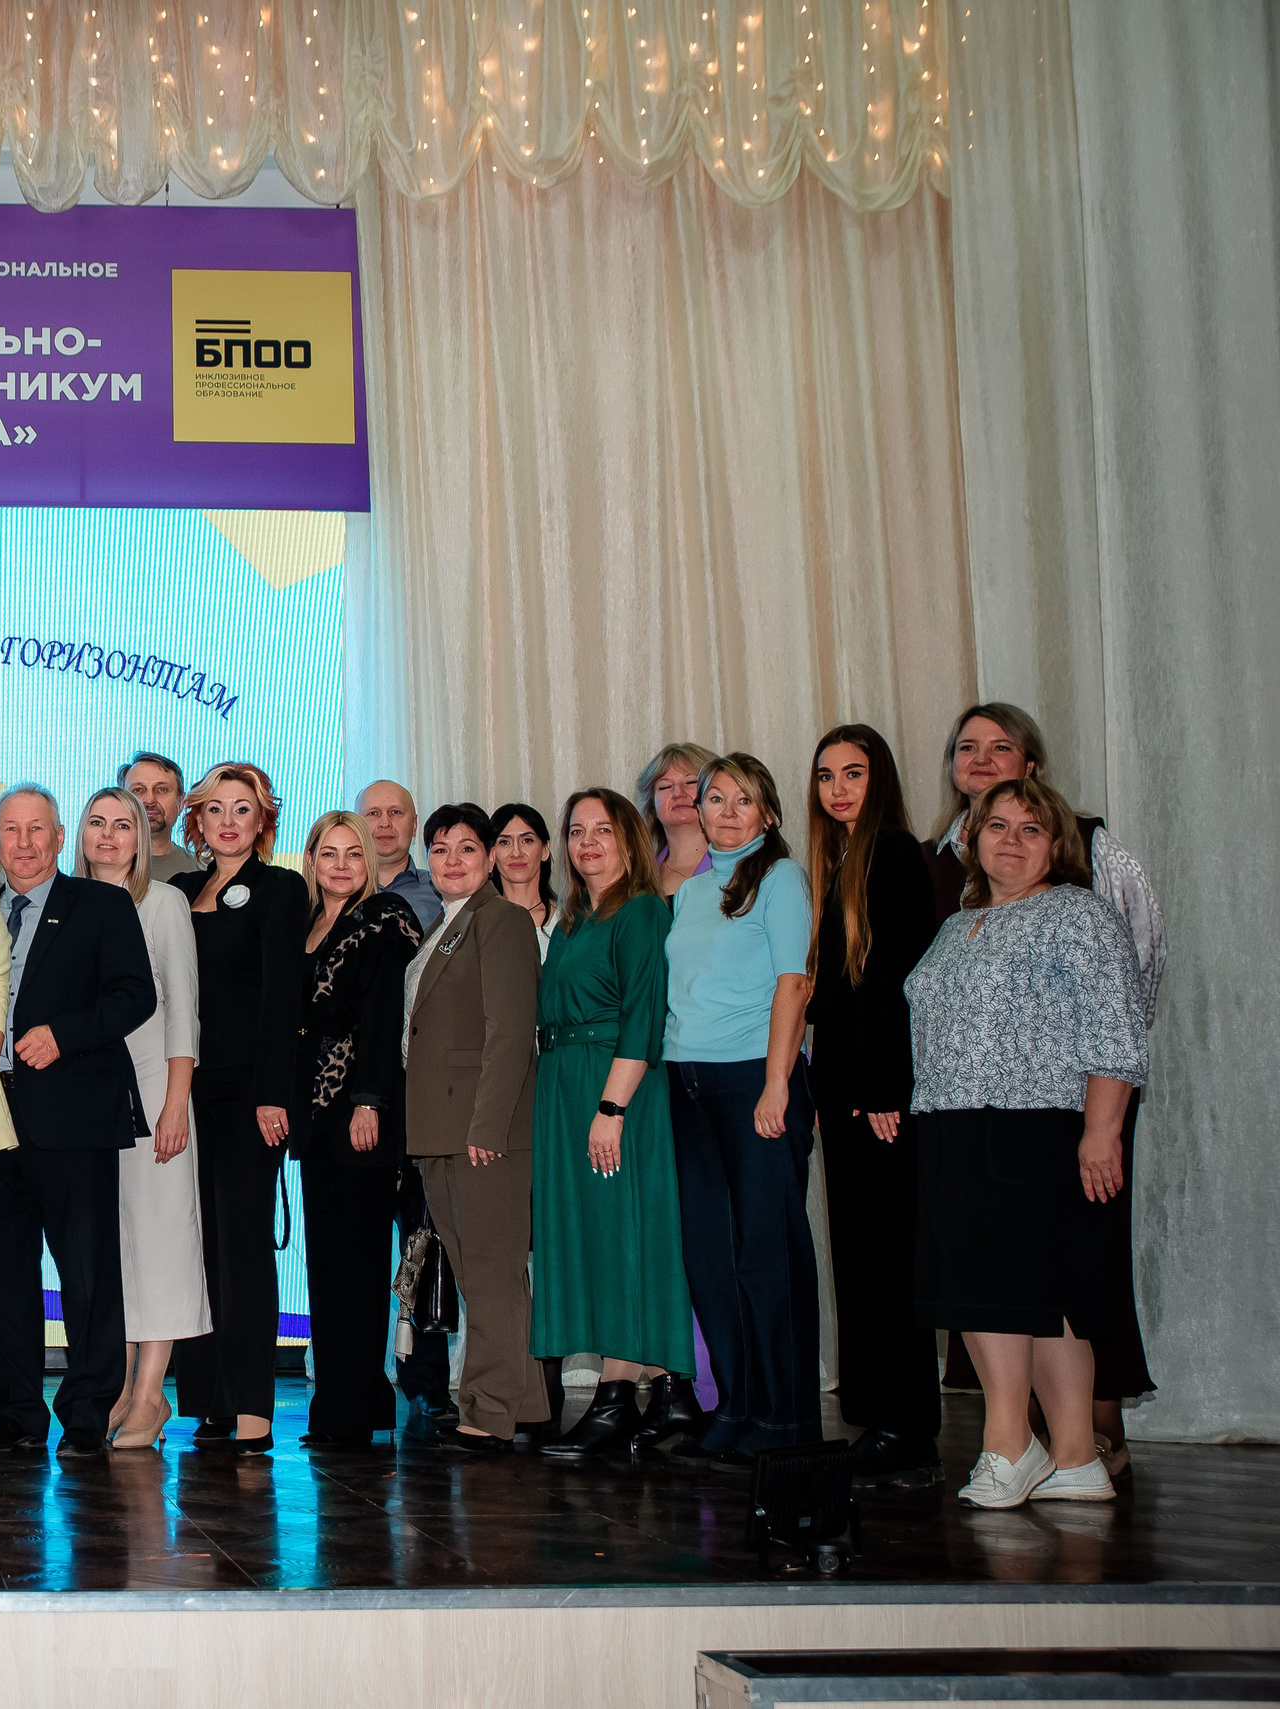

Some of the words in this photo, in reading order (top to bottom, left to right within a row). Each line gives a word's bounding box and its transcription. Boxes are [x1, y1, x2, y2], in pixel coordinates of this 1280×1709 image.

[195, 338, 312, 369] БПОО
[195, 373, 265, 381] ИНКЛЮЗИВНОЕ
[195, 381, 296, 390] ПРОФЕССИОНАЛЬНОЕ
[195, 390, 264, 398] ОБРАЗОВАНИЕ
[0, 636, 239, 721] ГОРИЗОНТАМ
